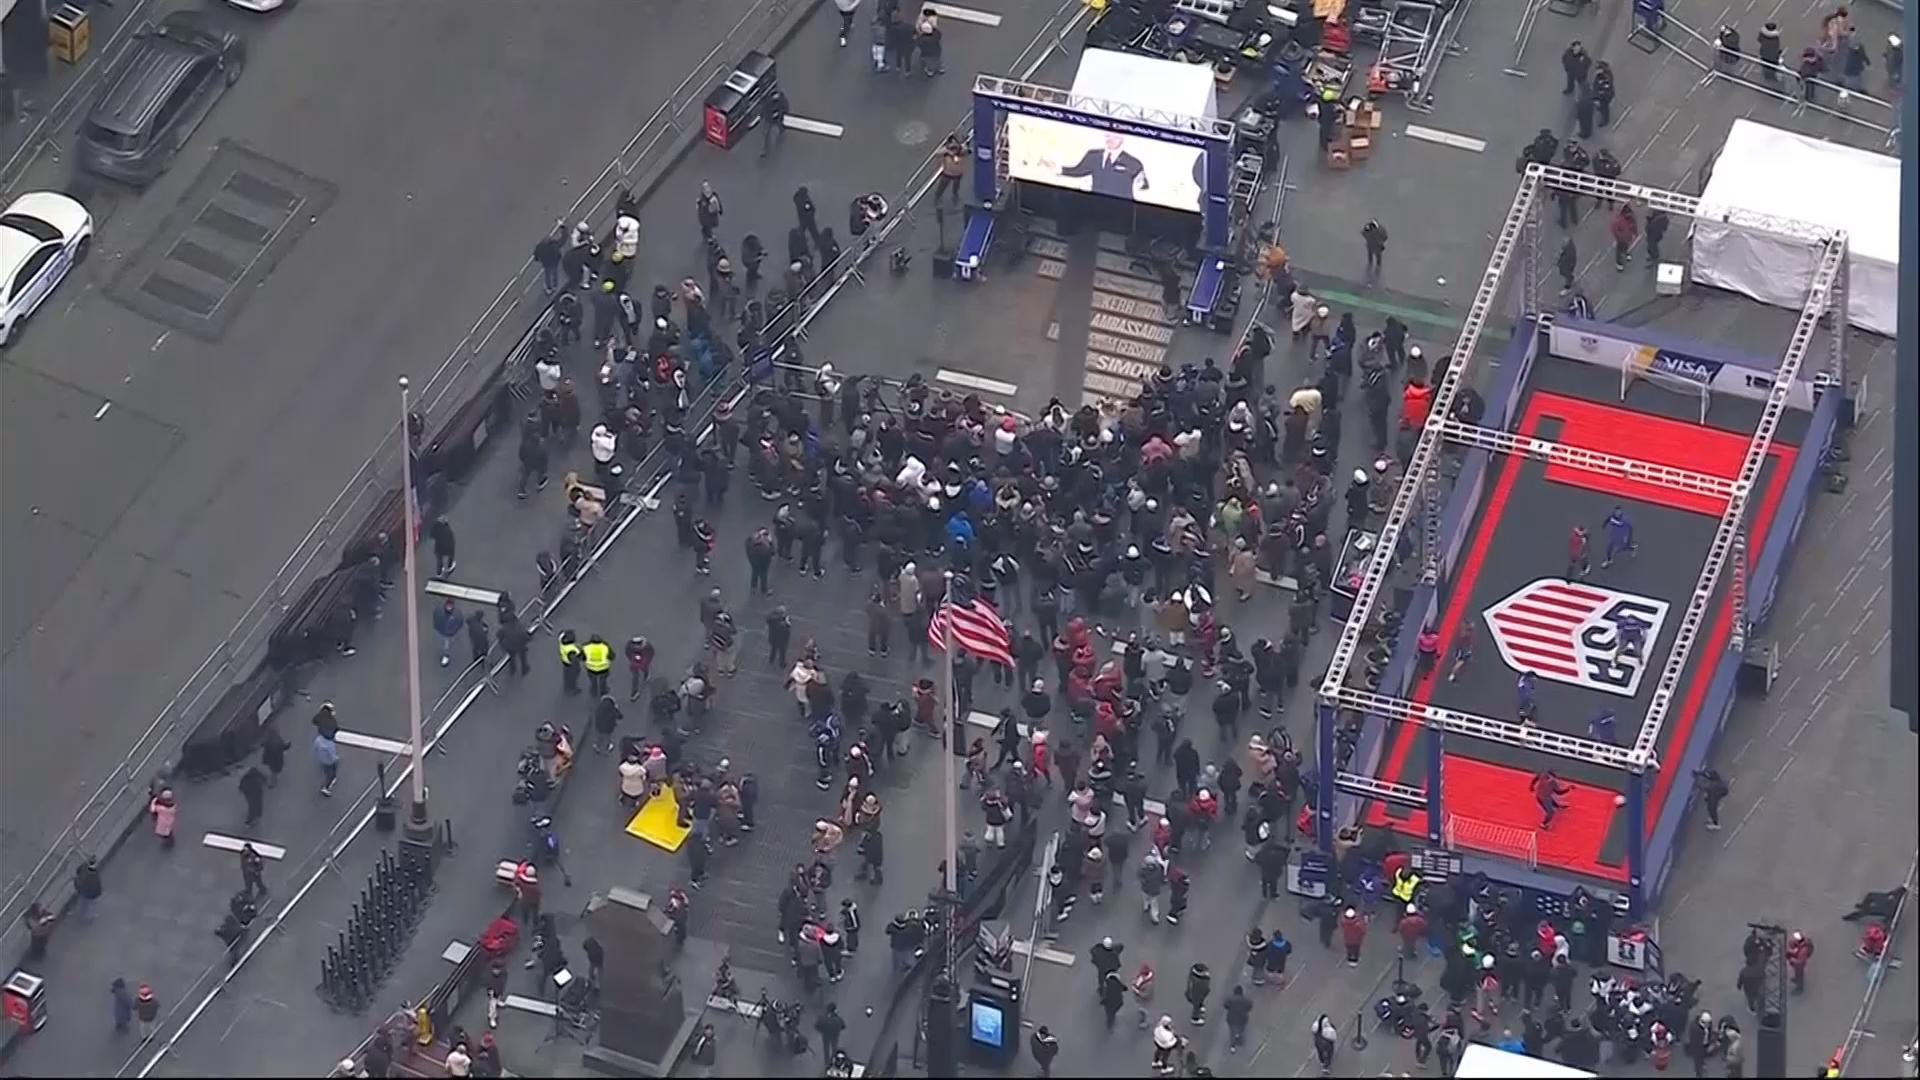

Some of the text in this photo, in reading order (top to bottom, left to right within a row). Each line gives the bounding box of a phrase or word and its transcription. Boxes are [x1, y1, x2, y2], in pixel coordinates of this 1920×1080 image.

[991, 99, 1020, 111] THE
[1022, 106, 1064, 118] ROAD
[1066, 113, 1087, 123] TO
[1090, 312, 1174, 344] AMBASSADOR
[1662, 356, 1708, 377] VISA
